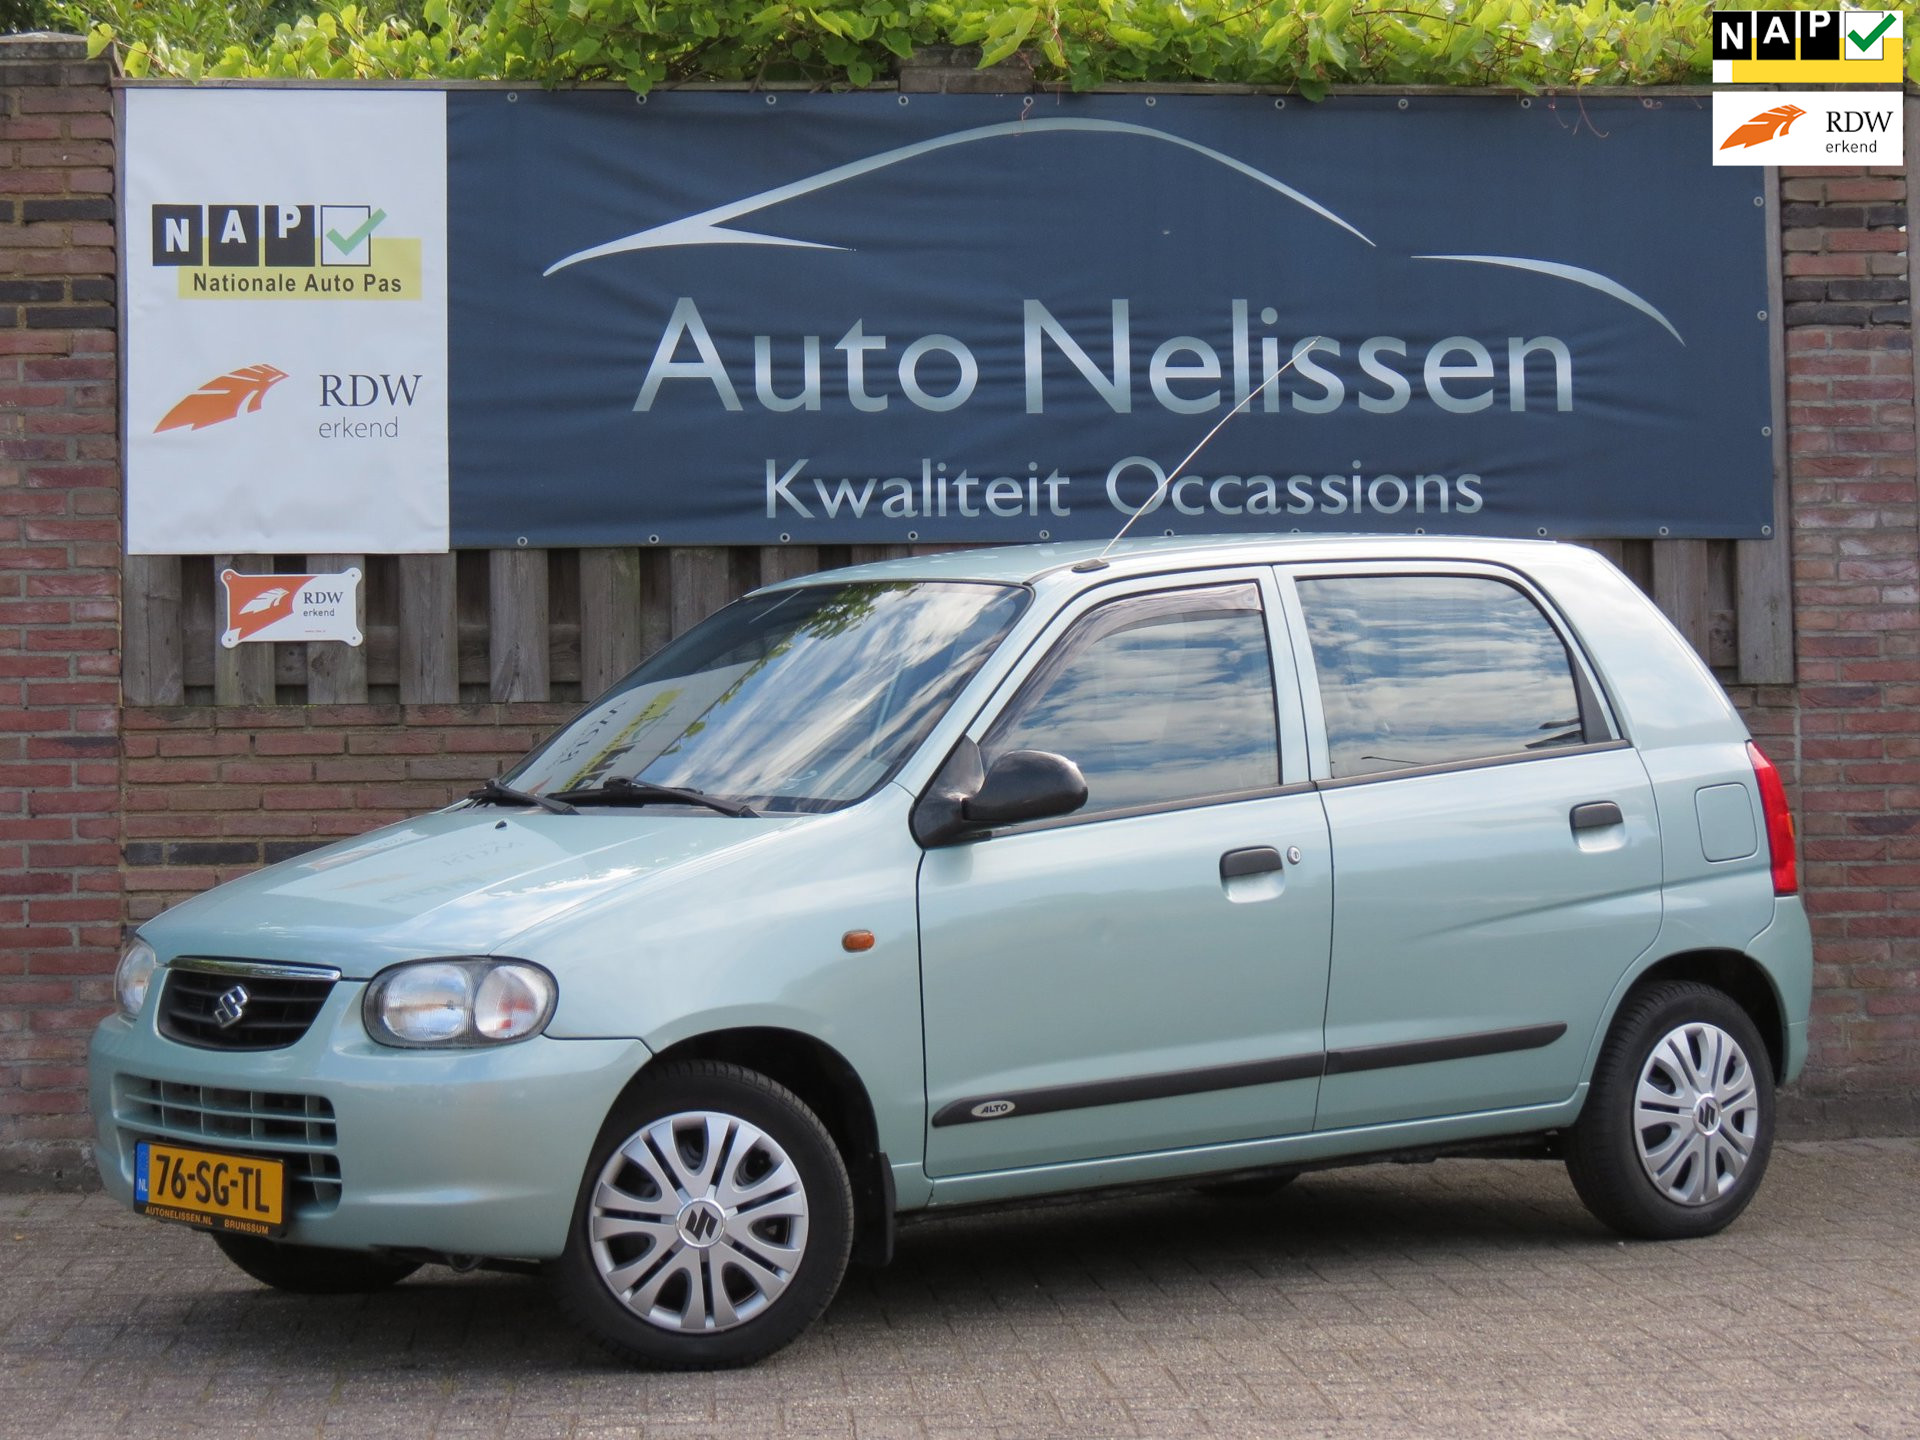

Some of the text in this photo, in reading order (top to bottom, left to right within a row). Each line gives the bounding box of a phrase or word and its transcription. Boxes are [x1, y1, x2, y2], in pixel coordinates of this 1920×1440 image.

[165, 205, 302, 252] NAP
[193, 273, 402, 292] Nationale Auto Pas
[632, 297, 1574, 415] Auto Nelissen
[319, 374, 422, 407] RDW
[318, 417, 399, 438] erkend
[766, 456, 1484, 519] Kwaliteit Occassions
[303, 591, 344, 604] RDW
[303, 608, 335, 617] erkend
[981, 1103, 1008, 1114] ALTO
[138, 1178, 148, 1191] NL
[155, 1154, 270, 1213] 76-SG-TL
[145, 1207, 269, 1234] AUTONELISSEN.NL BRUNSSUM
